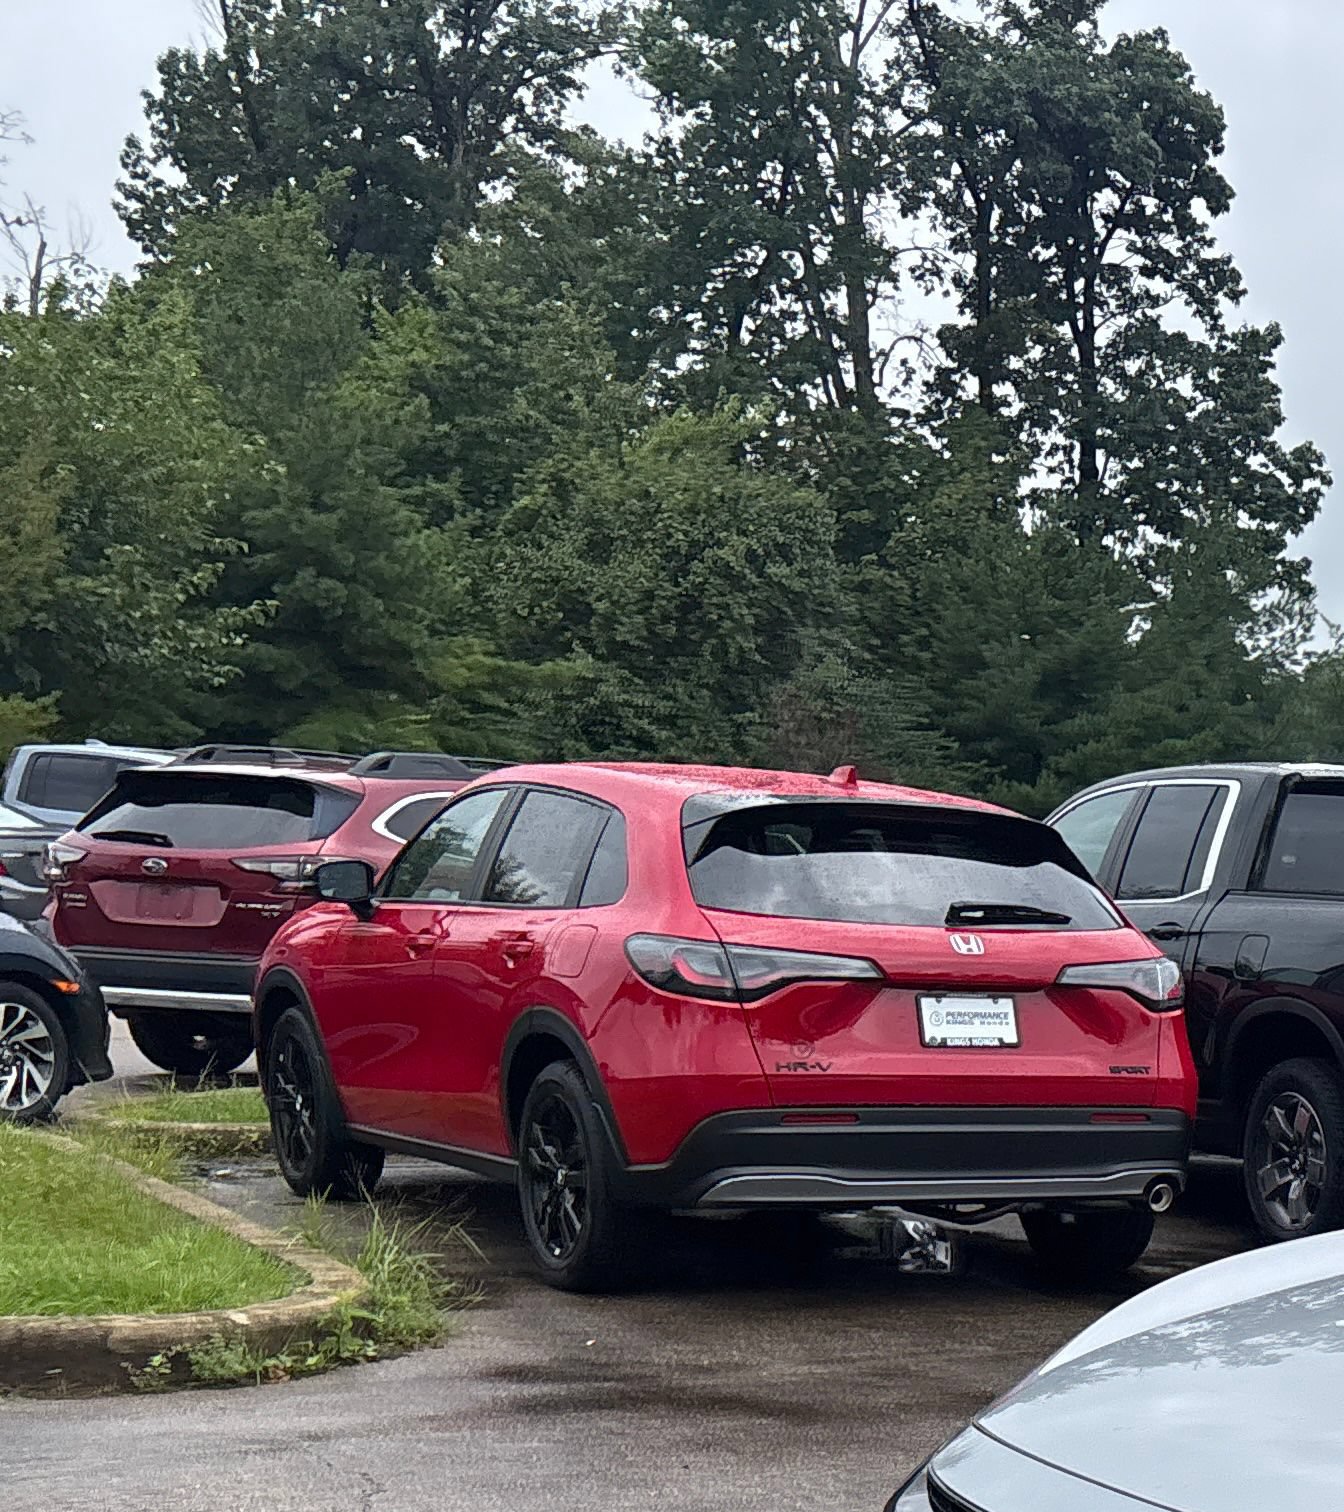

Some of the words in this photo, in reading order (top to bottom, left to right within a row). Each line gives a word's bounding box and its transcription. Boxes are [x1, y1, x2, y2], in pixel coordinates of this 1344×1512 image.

[945, 1011, 1009, 1020] PERFORMANCE
[775, 1061, 834, 1073] HR-V
[1108, 1065, 1152, 1075] SPORT
